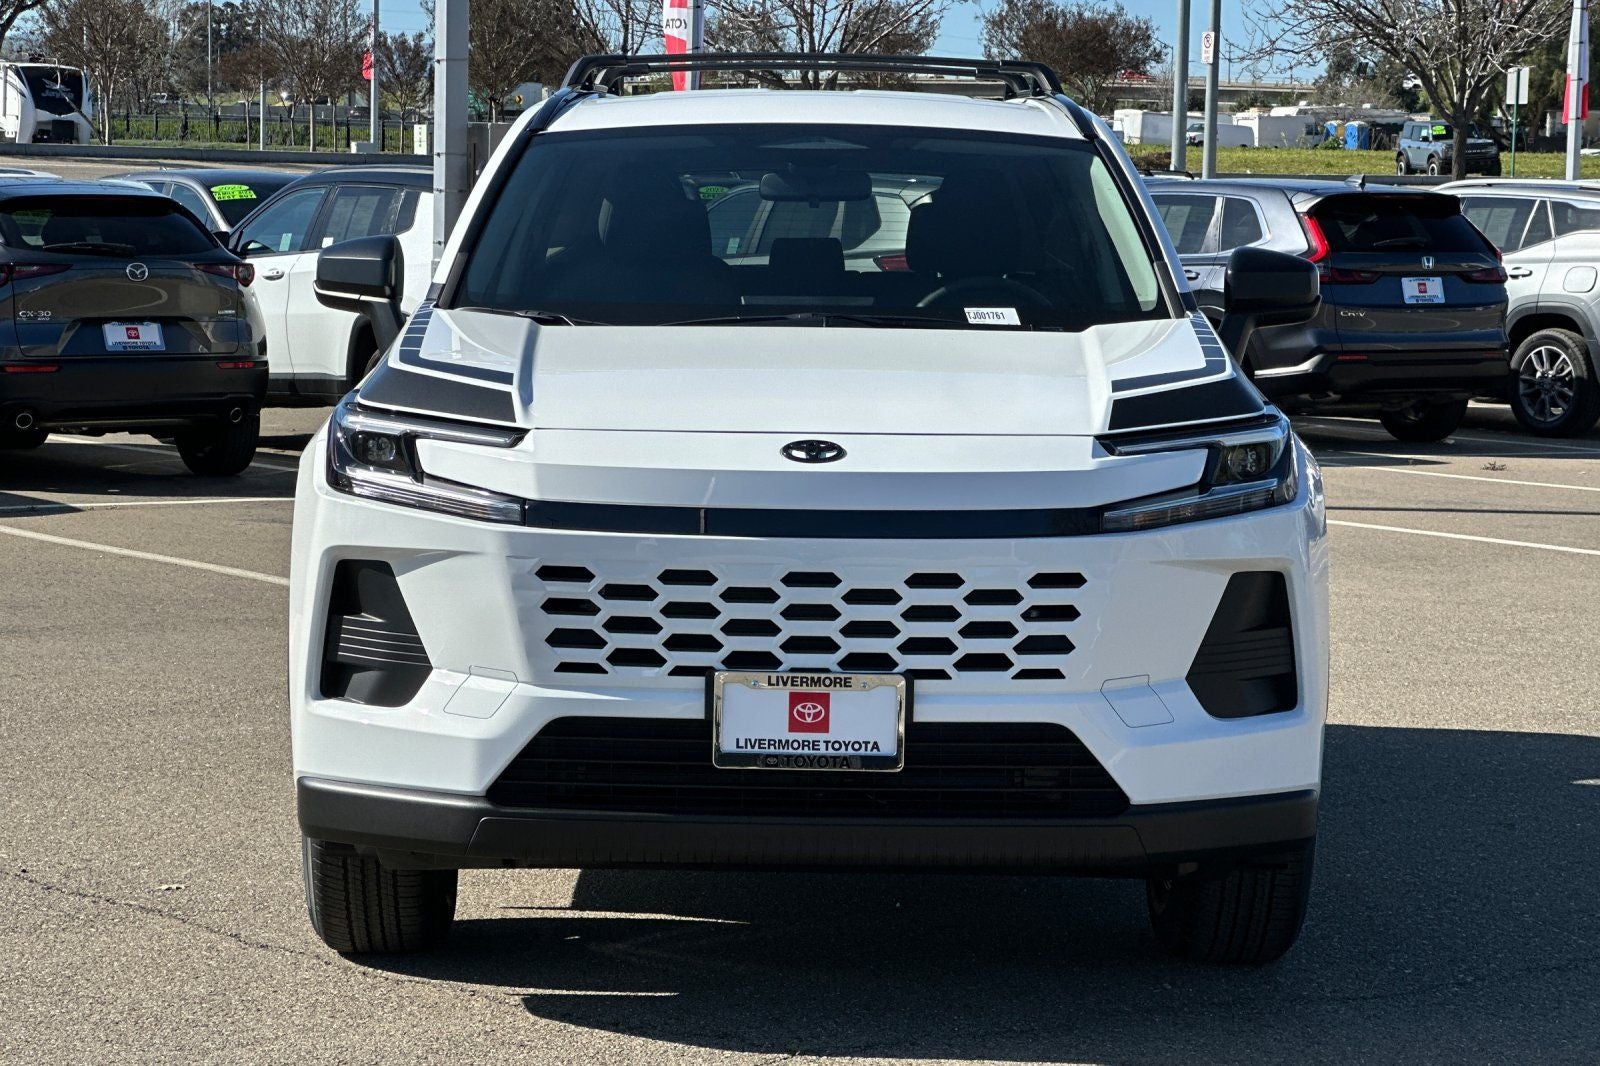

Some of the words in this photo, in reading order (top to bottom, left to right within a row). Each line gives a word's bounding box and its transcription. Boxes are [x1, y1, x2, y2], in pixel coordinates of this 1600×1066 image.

[767, 675, 853, 688] LIVERMORE
[735, 737, 821, 752] LIVERMORE
[822, 739, 881, 753] TOYOTA
[784, 755, 851, 769] TOYOTA
